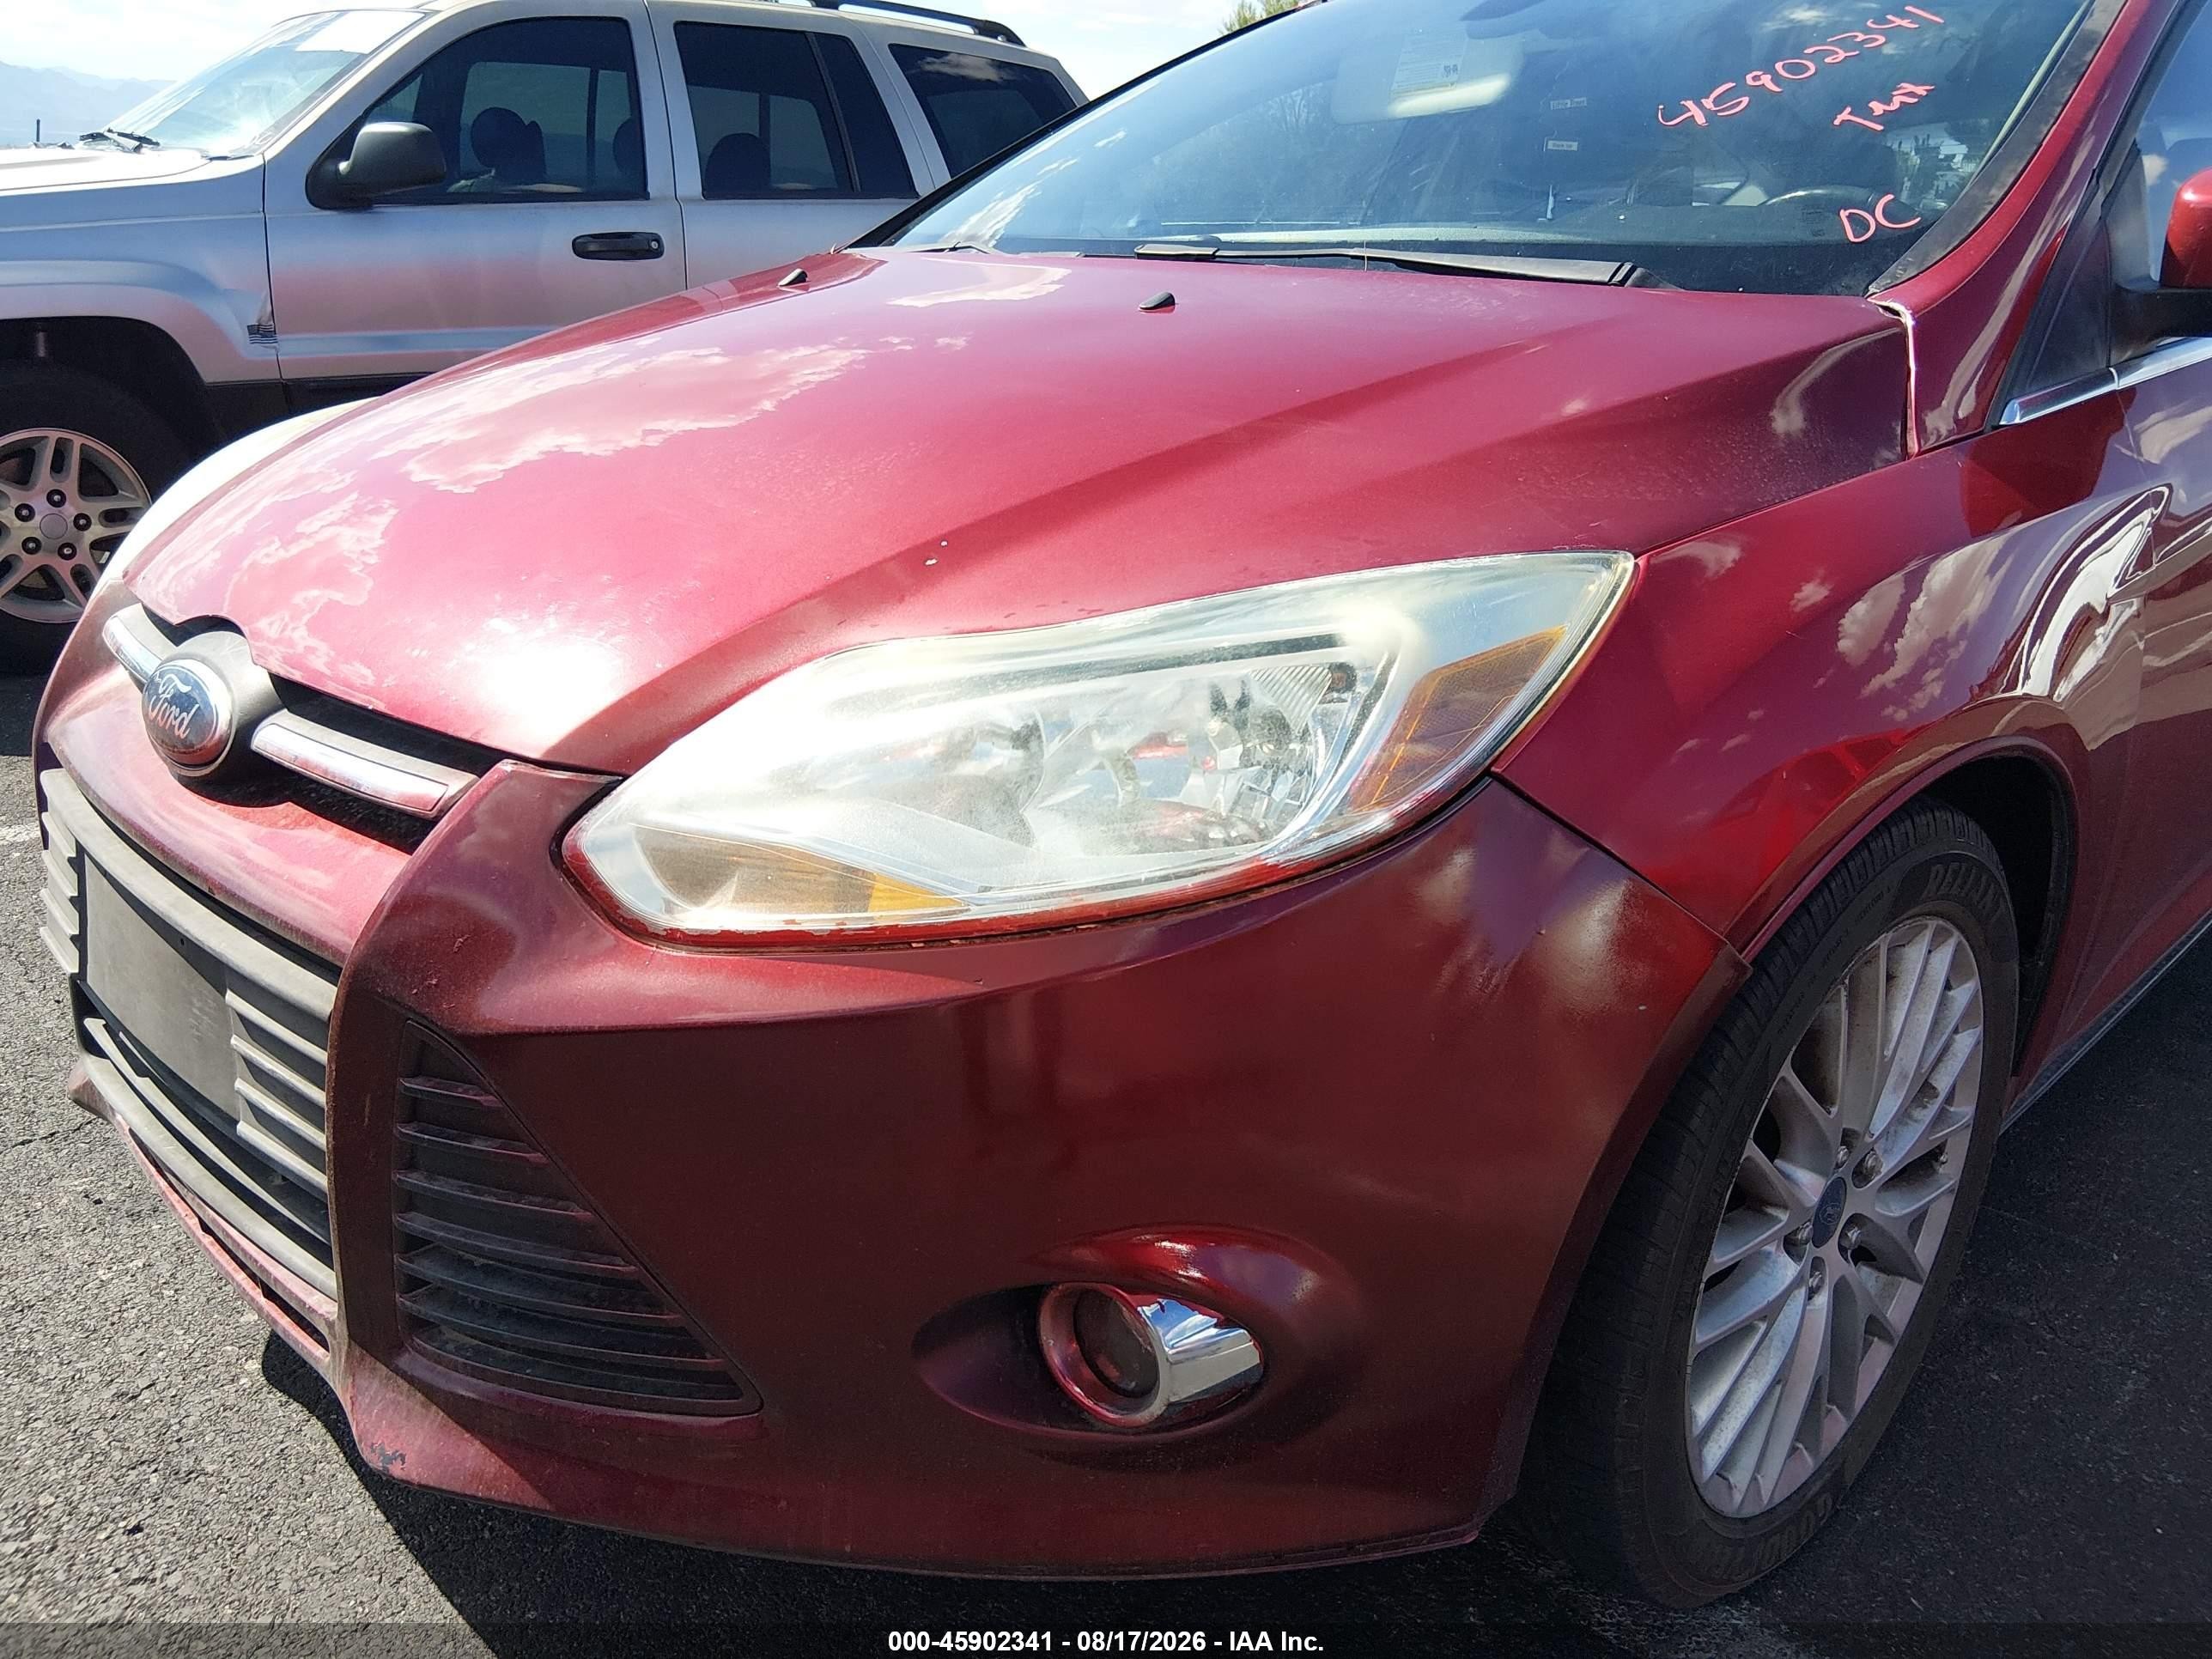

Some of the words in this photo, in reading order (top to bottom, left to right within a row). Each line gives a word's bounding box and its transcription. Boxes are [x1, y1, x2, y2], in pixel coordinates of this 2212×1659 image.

[1658, 6, 1944, 126] 45902341
[1840, 194, 1921, 242] DC
[149, 673, 200, 739] Ford
